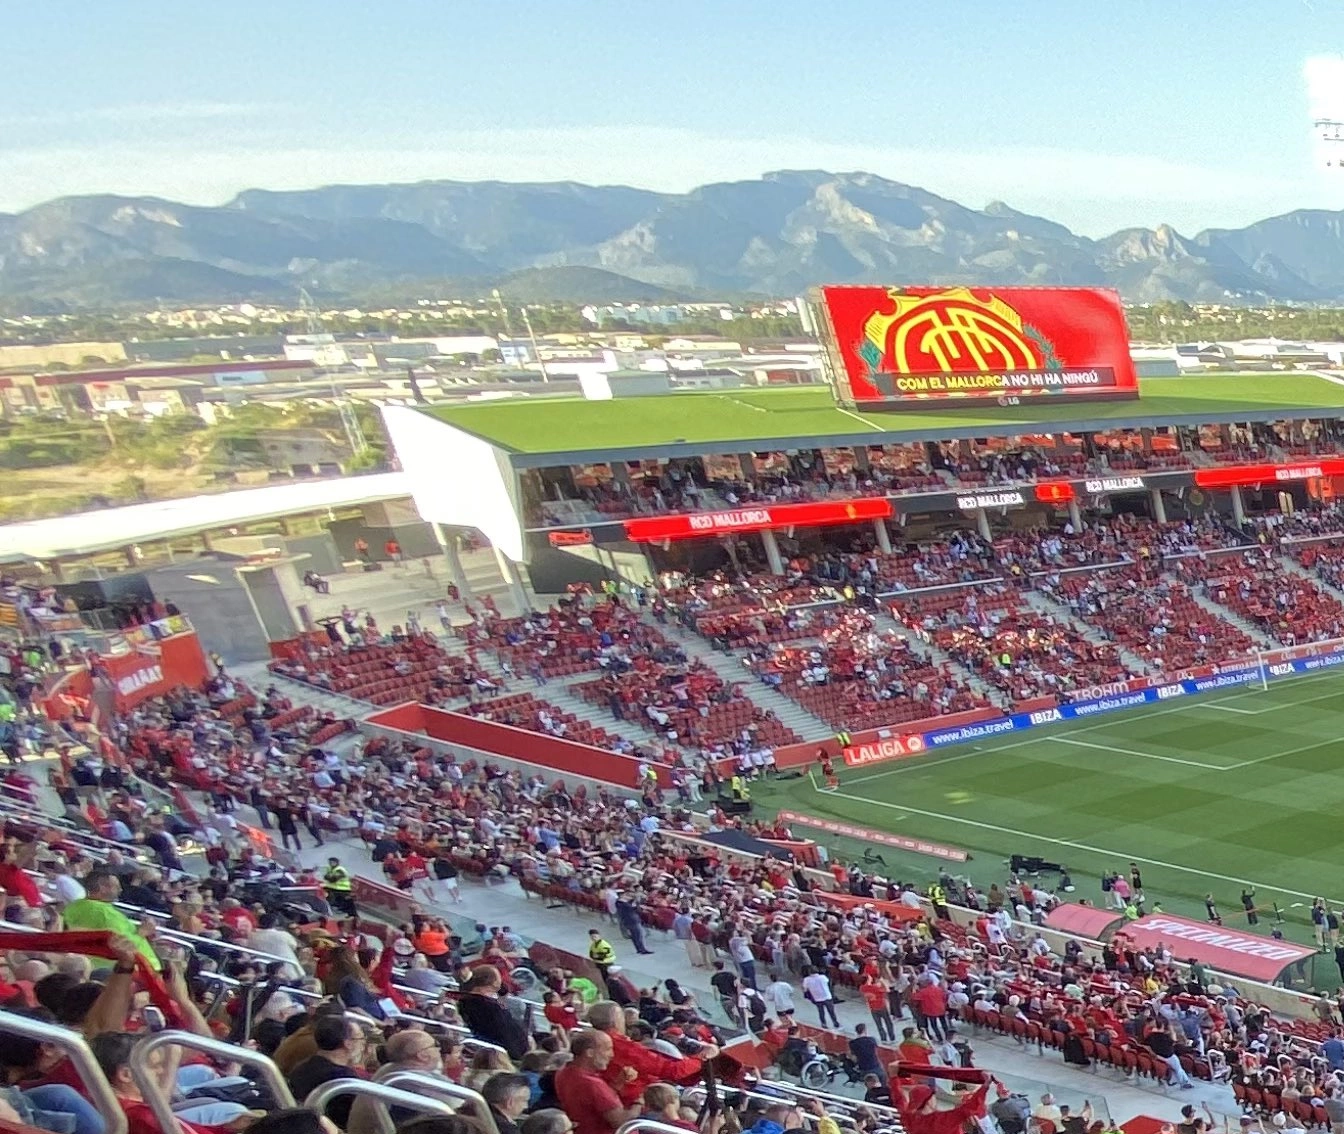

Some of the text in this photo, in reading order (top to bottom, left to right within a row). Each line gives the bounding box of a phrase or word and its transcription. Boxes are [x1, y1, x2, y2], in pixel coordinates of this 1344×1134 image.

[896, 370, 1098, 391] COM EL MALLORCA NO HI HA NINGÚ
[1103, 477, 1144, 490] MALLORCA
[982, 492, 1025, 507] MALLORCA
[715, 509, 772, 528] MALLORCA
[1069, 681, 1130, 703] TROHM
[1157, 683, 1186, 700] IBIZA
[1075, 692, 1146, 716] www.ibiza.travel
[1030, 708, 1063, 725] IBIZA
[932, 719, 1014, 745] www.ibiza.travel
[850, 740, 905, 766] LALIGA
[1132, 918, 1304, 961] SPECIALIZED
